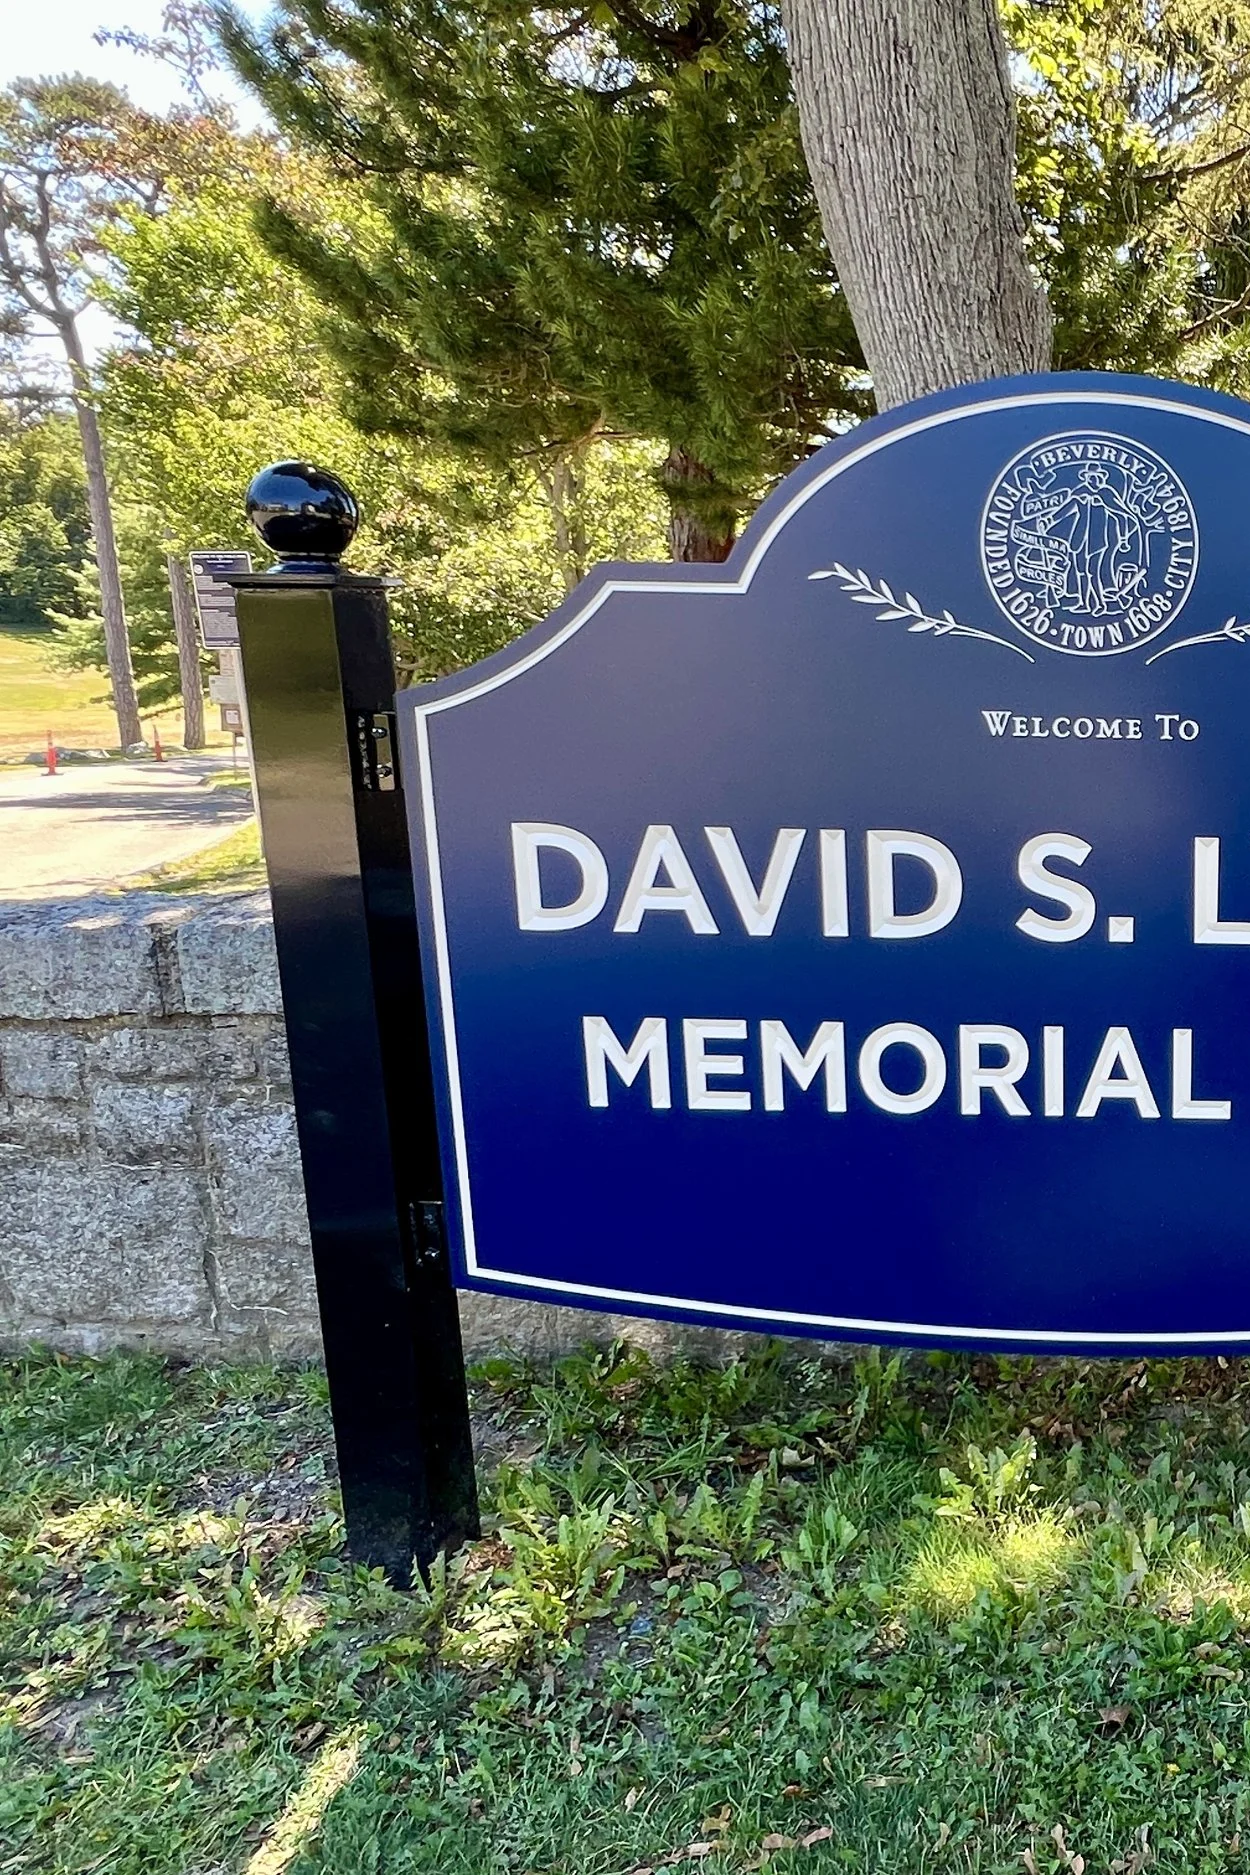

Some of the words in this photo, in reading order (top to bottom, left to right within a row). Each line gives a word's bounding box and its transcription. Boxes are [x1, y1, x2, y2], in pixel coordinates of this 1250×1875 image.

[1039, 444, 1143, 476] BEVERLY
[1025, 494, 1065, 513] PATRI
[1158, 482, 1192, 532] 1894
[1018, 563, 1065, 586] PROLES
[1165, 539, 1194, 590] CITY
[1002, 587, 1054, 634] 1626
[1126, 592, 1174, 639] 1668
[1060, 621, 1125, 649] TOWN
[981, 709, 1143, 740] WELCOME
[510, 822, 963, 939] DAVID
[1014, 831, 1134, 944] S.
[582, 1015, 1232, 1120] MEMORIAL
